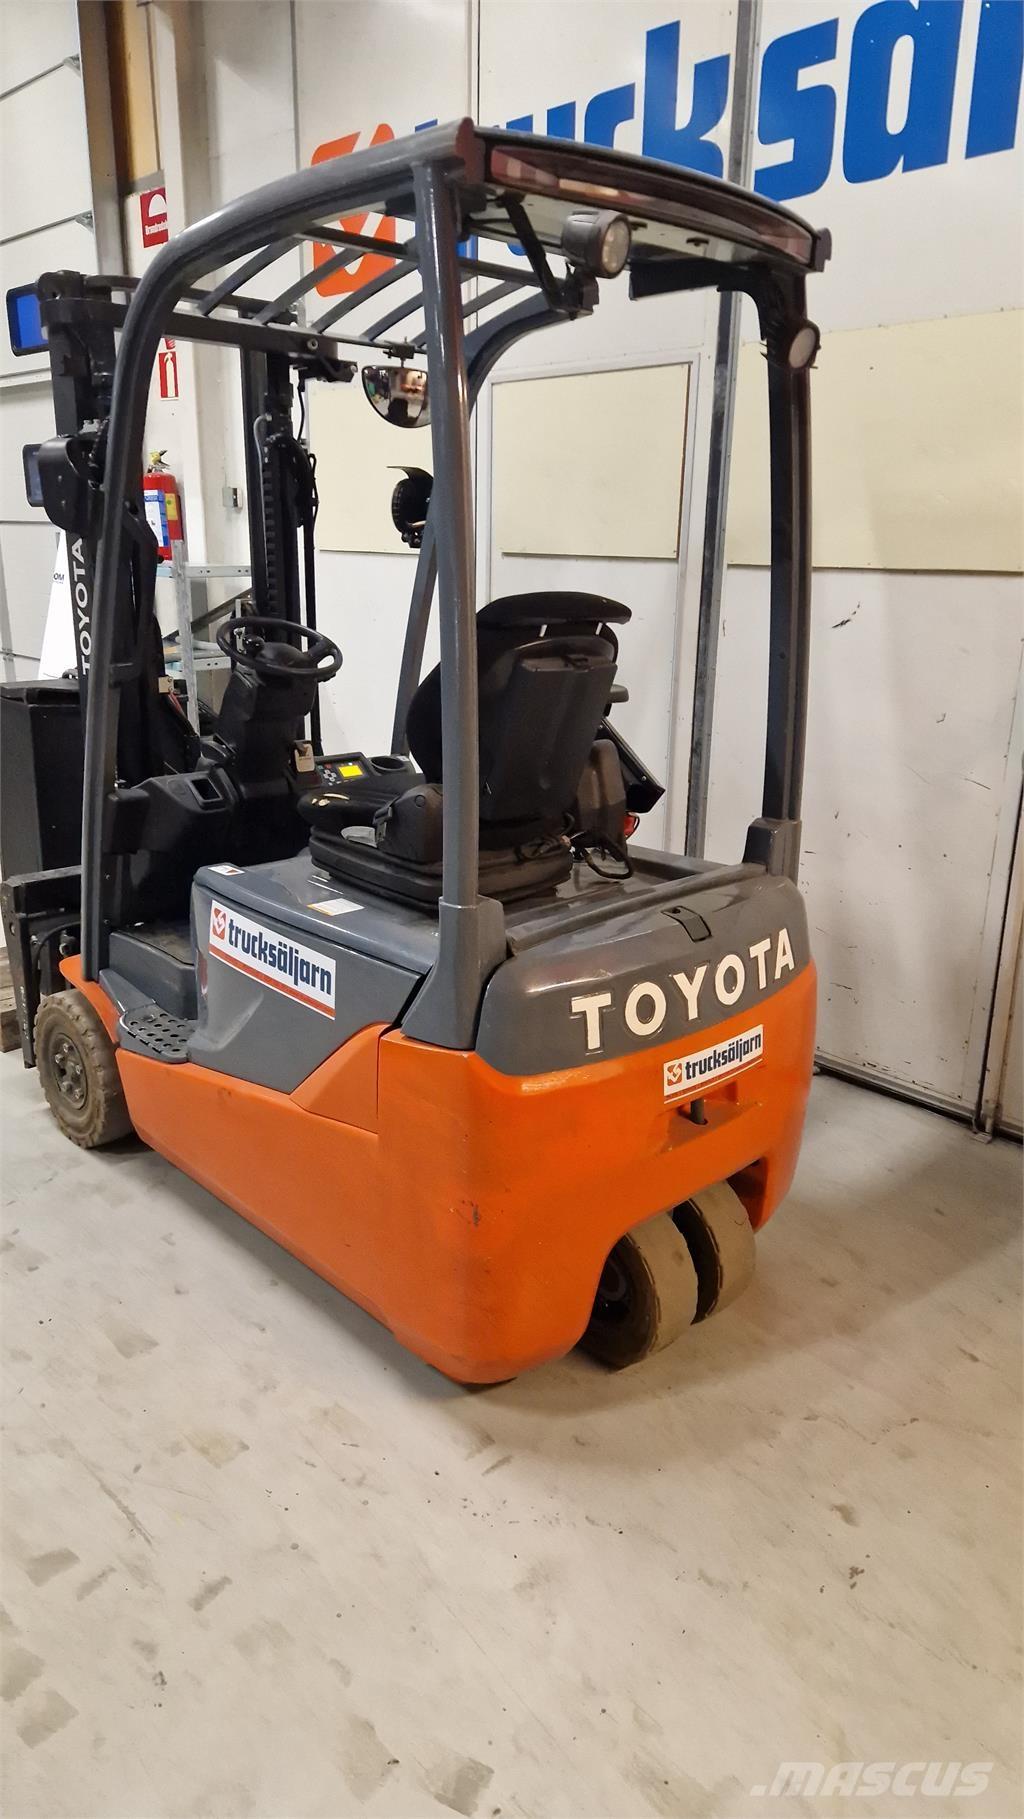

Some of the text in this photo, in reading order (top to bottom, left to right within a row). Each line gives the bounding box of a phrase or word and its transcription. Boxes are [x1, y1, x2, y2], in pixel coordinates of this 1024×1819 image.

[71, 537, 92, 676] TOYOTA
[228, 918, 332, 995] trucksäljarn
[571, 927, 795, 1051] TOYOTA
[685, 1033, 762, 1081] trucksäljarn
